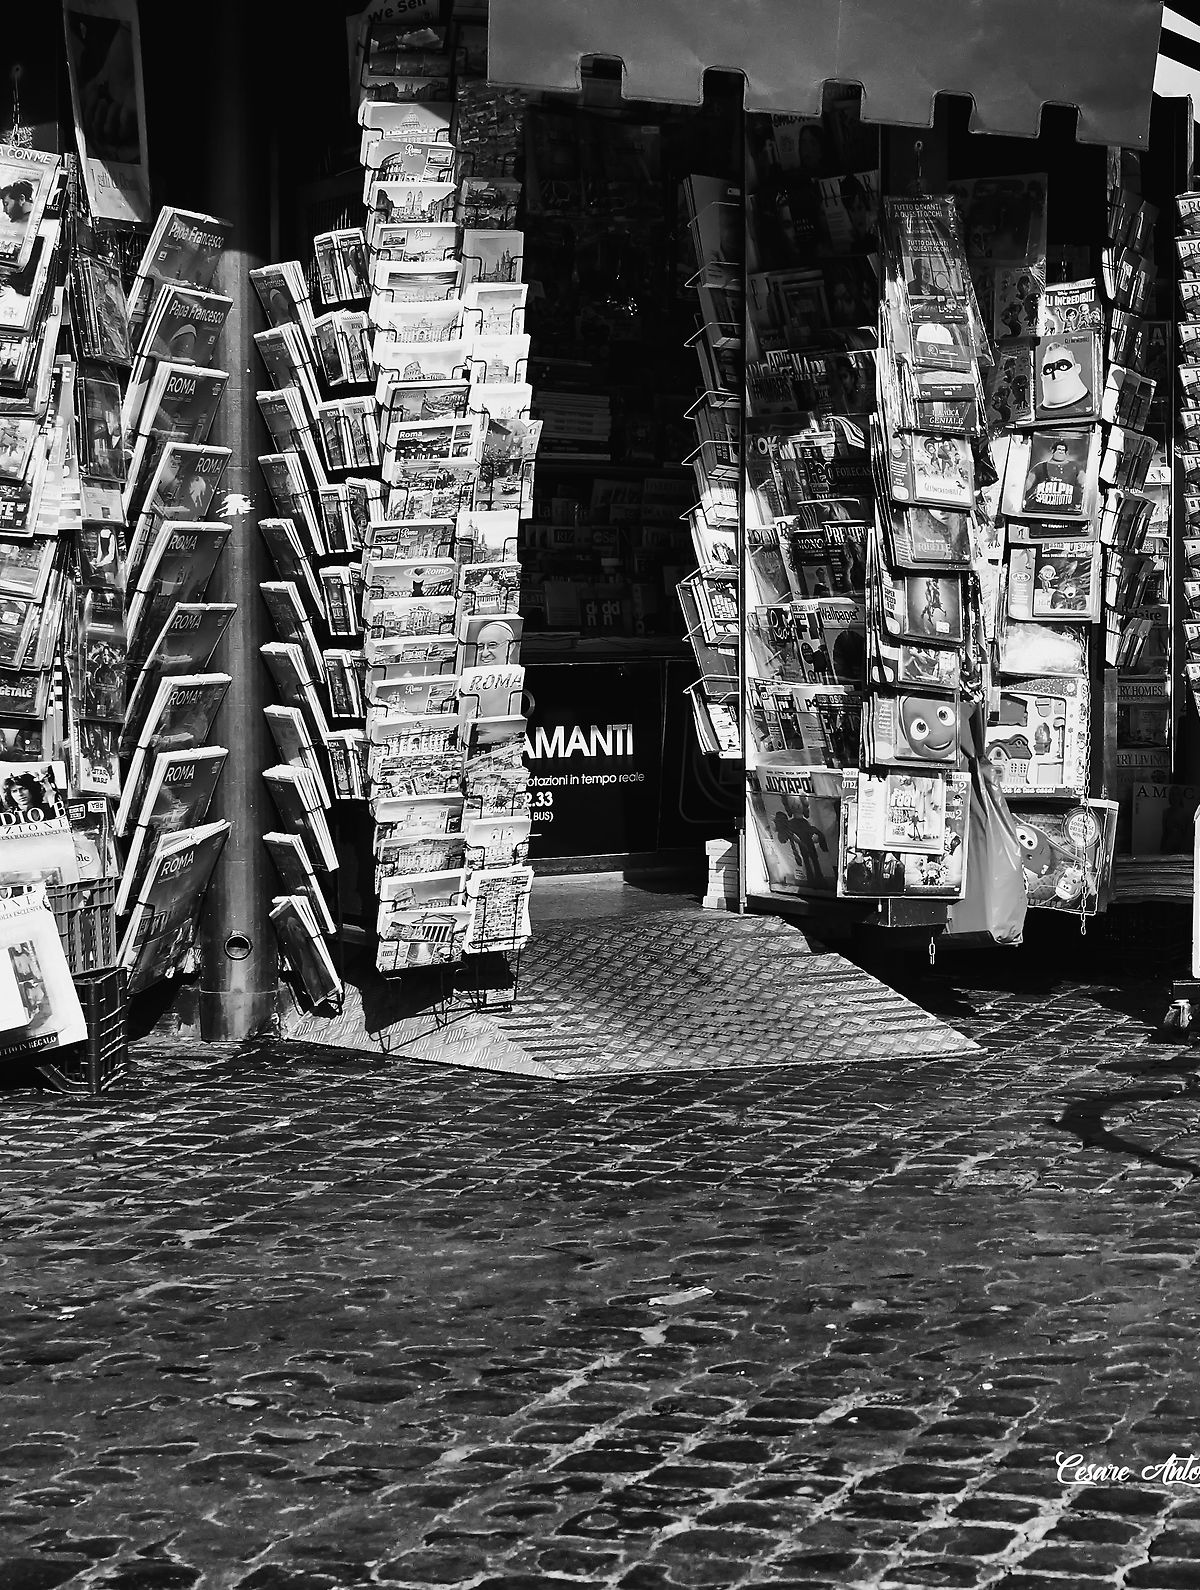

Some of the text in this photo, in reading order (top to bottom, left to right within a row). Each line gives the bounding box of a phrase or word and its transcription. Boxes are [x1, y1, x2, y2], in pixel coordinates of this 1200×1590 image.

[7, 149, 53, 164] CON ME
[168, 221, 224, 248] Papa Francesco
[1055, 289, 1095, 306] INCREDIBILI
[169, 300, 224, 323] Papa Francesco
[167, 376, 196, 395] ROMA
[929, 417, 964, 425] GENIALE
[195, 457, 223, 473] ROMA
[1037, 481, 1074, 495] RALPH
[168, 535, 198, 550] ROMA
[425, 566, 450, 575] Rome
[171, 615, 202, 629] ROMA
[468, 673, 523, 691] ROMA
[168, 690, 199, 705] ROMA
[1135, 685, 1163, 696] HOMES
[165, 764, 195, 782] ROMA
[570, 774, 579, 784] in
[581, 773, 617, 787] tempo
[618, 772, 645, 783] reale
[161, 850, 194, 876] ROMA
[29, 1036, 57, 1048] REGALO
